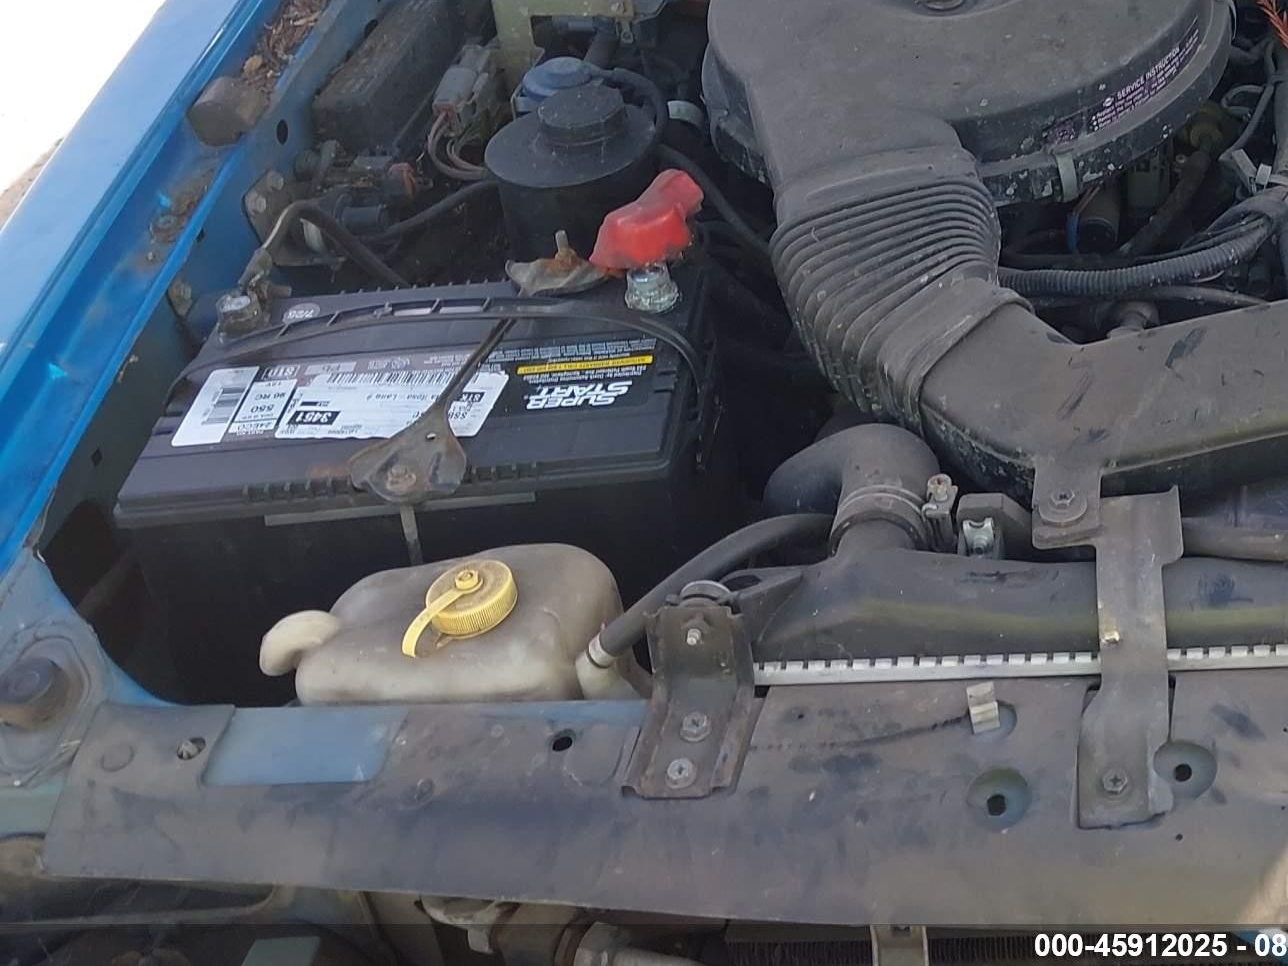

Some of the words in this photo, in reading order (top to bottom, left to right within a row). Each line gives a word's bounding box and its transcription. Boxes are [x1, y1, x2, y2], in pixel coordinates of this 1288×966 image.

[1116, 74, 1146, 100] SERVICE
[537, 380, 633, 397] START
[250, 404, 275, 413] 550
[526, 394, 616, 410] SUPER
[295, 412, 332, 424] 3451
